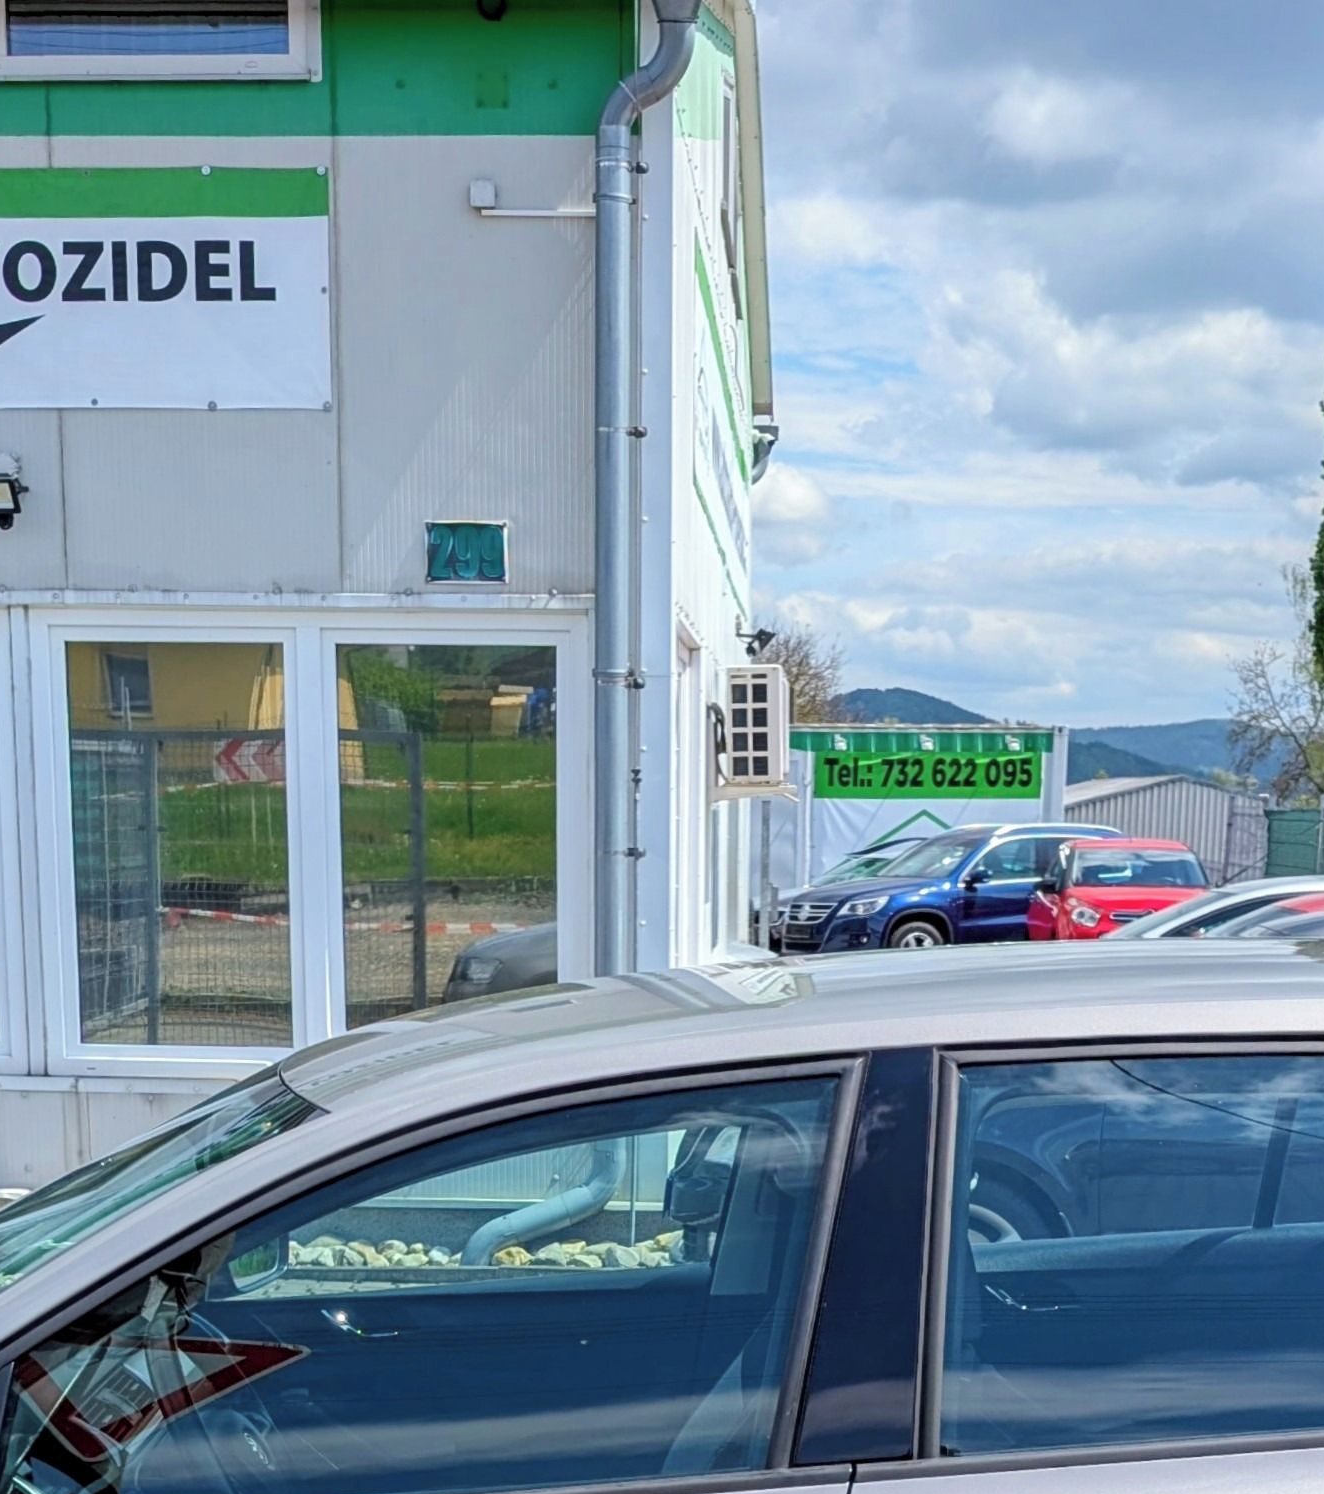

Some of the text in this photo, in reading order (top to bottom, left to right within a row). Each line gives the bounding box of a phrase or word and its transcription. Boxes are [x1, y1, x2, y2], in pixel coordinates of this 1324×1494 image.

[430, 525, 503, 578] 299
[824, 757, 1033, 788] Tel.: 732 622 095
